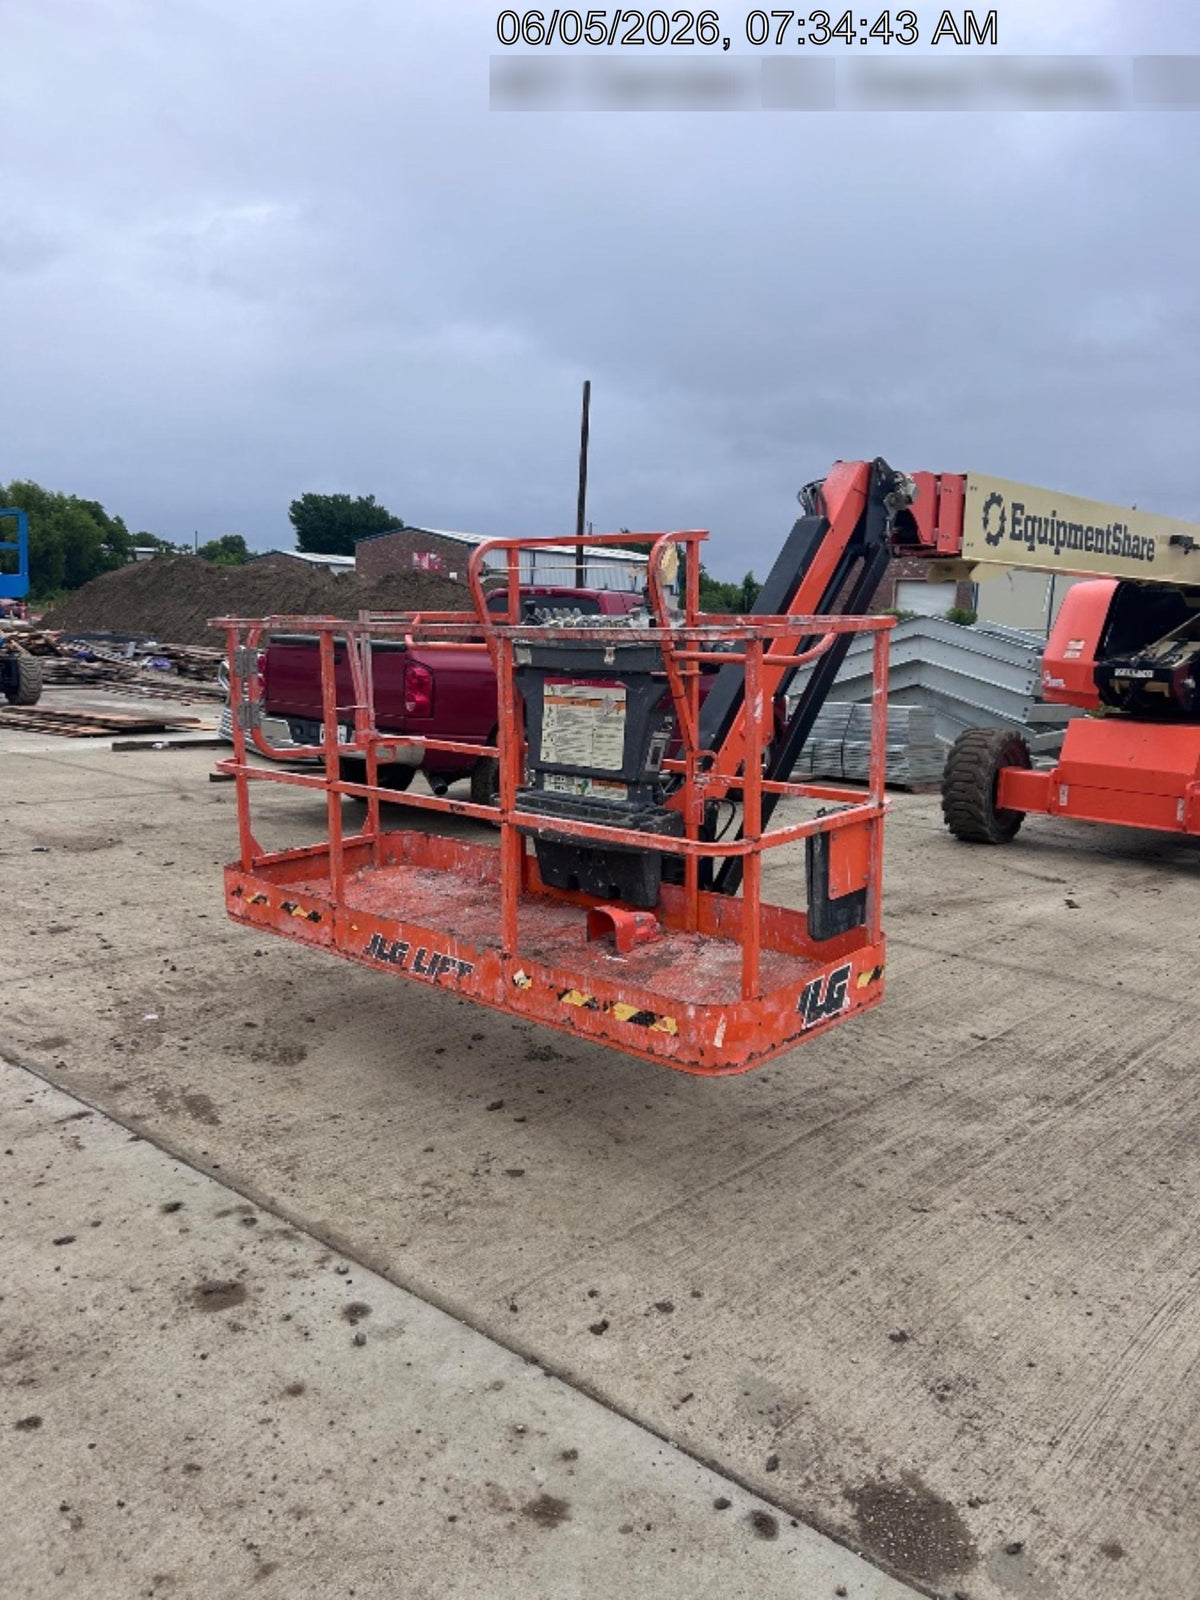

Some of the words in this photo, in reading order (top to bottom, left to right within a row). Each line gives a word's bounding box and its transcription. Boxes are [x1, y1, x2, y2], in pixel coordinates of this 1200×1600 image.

[1009, 502, 1155, 561] EquipmentShare
[363, 932, 410, 965] JLG
[411, 947, 475, 984] LIFT
[797, 962, 851, 1029] JLG
